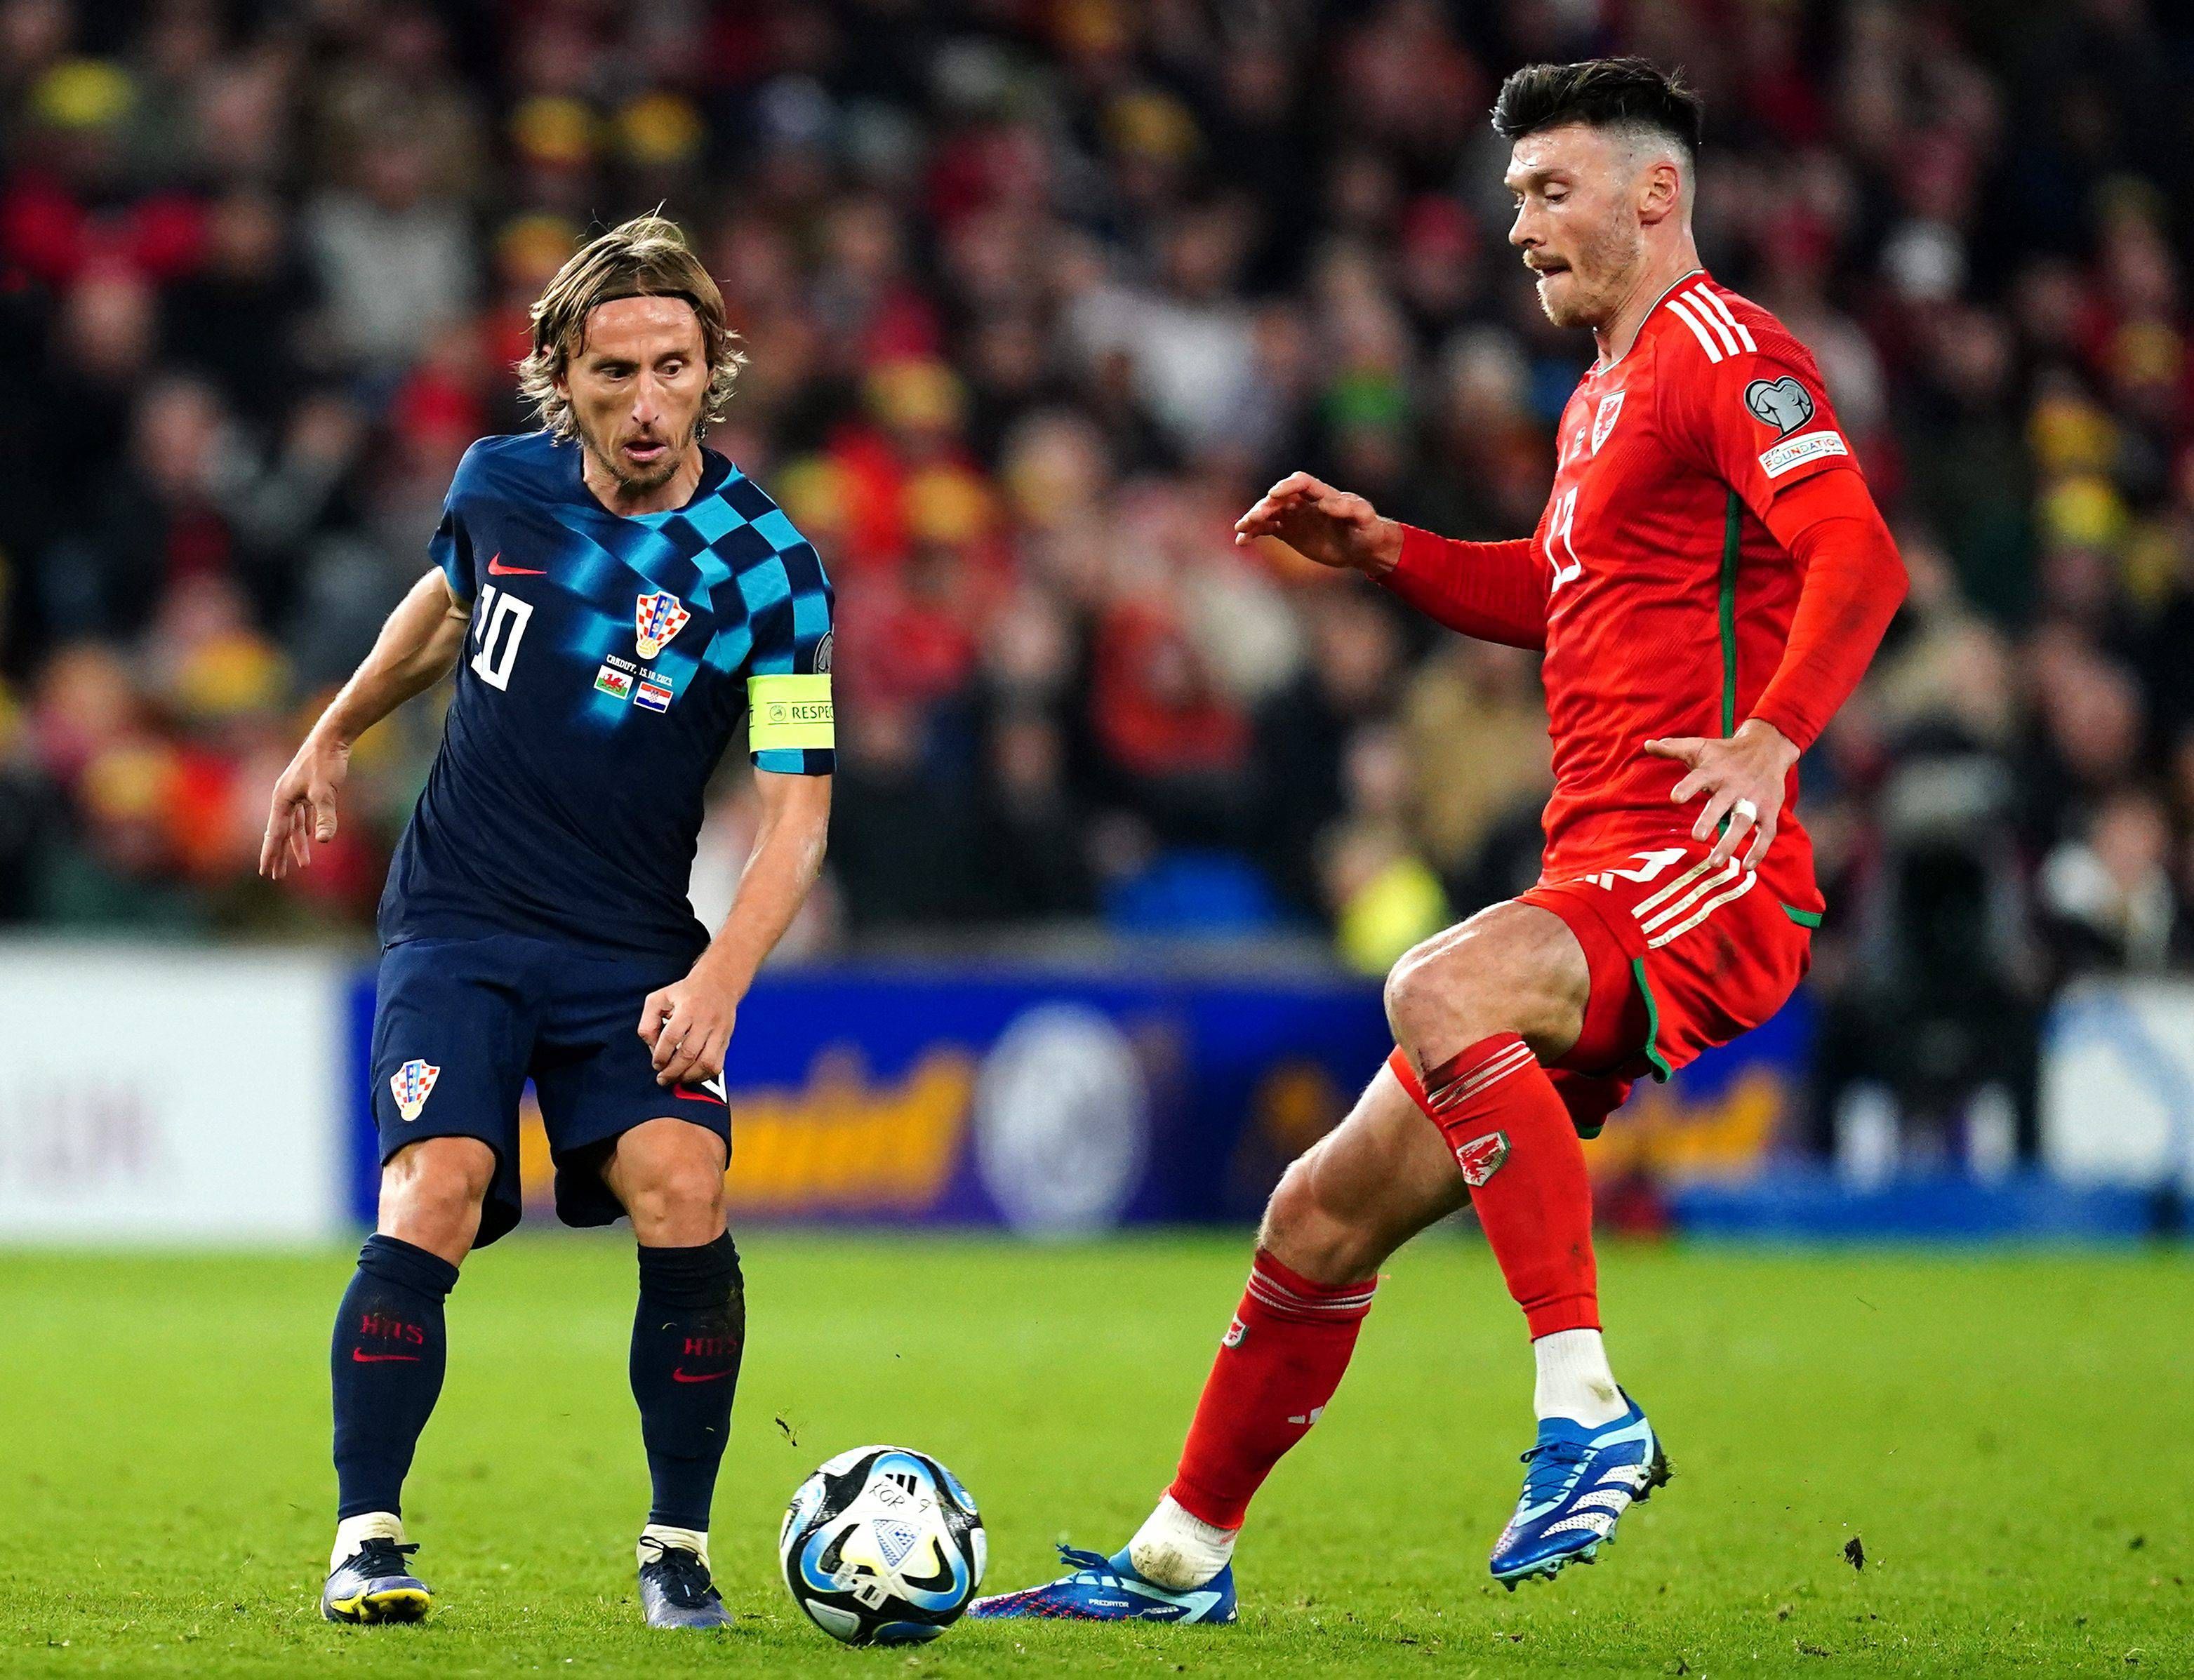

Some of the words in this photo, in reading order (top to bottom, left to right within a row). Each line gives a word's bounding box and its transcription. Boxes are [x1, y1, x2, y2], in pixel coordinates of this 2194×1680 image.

[1766, 439, 1842, 469] FOUNDATION
[651, 599, 670, 632] HNS
[471, 583, 533, 691] 10
[1089, 1599, 1129, 1608] PREDATOR
